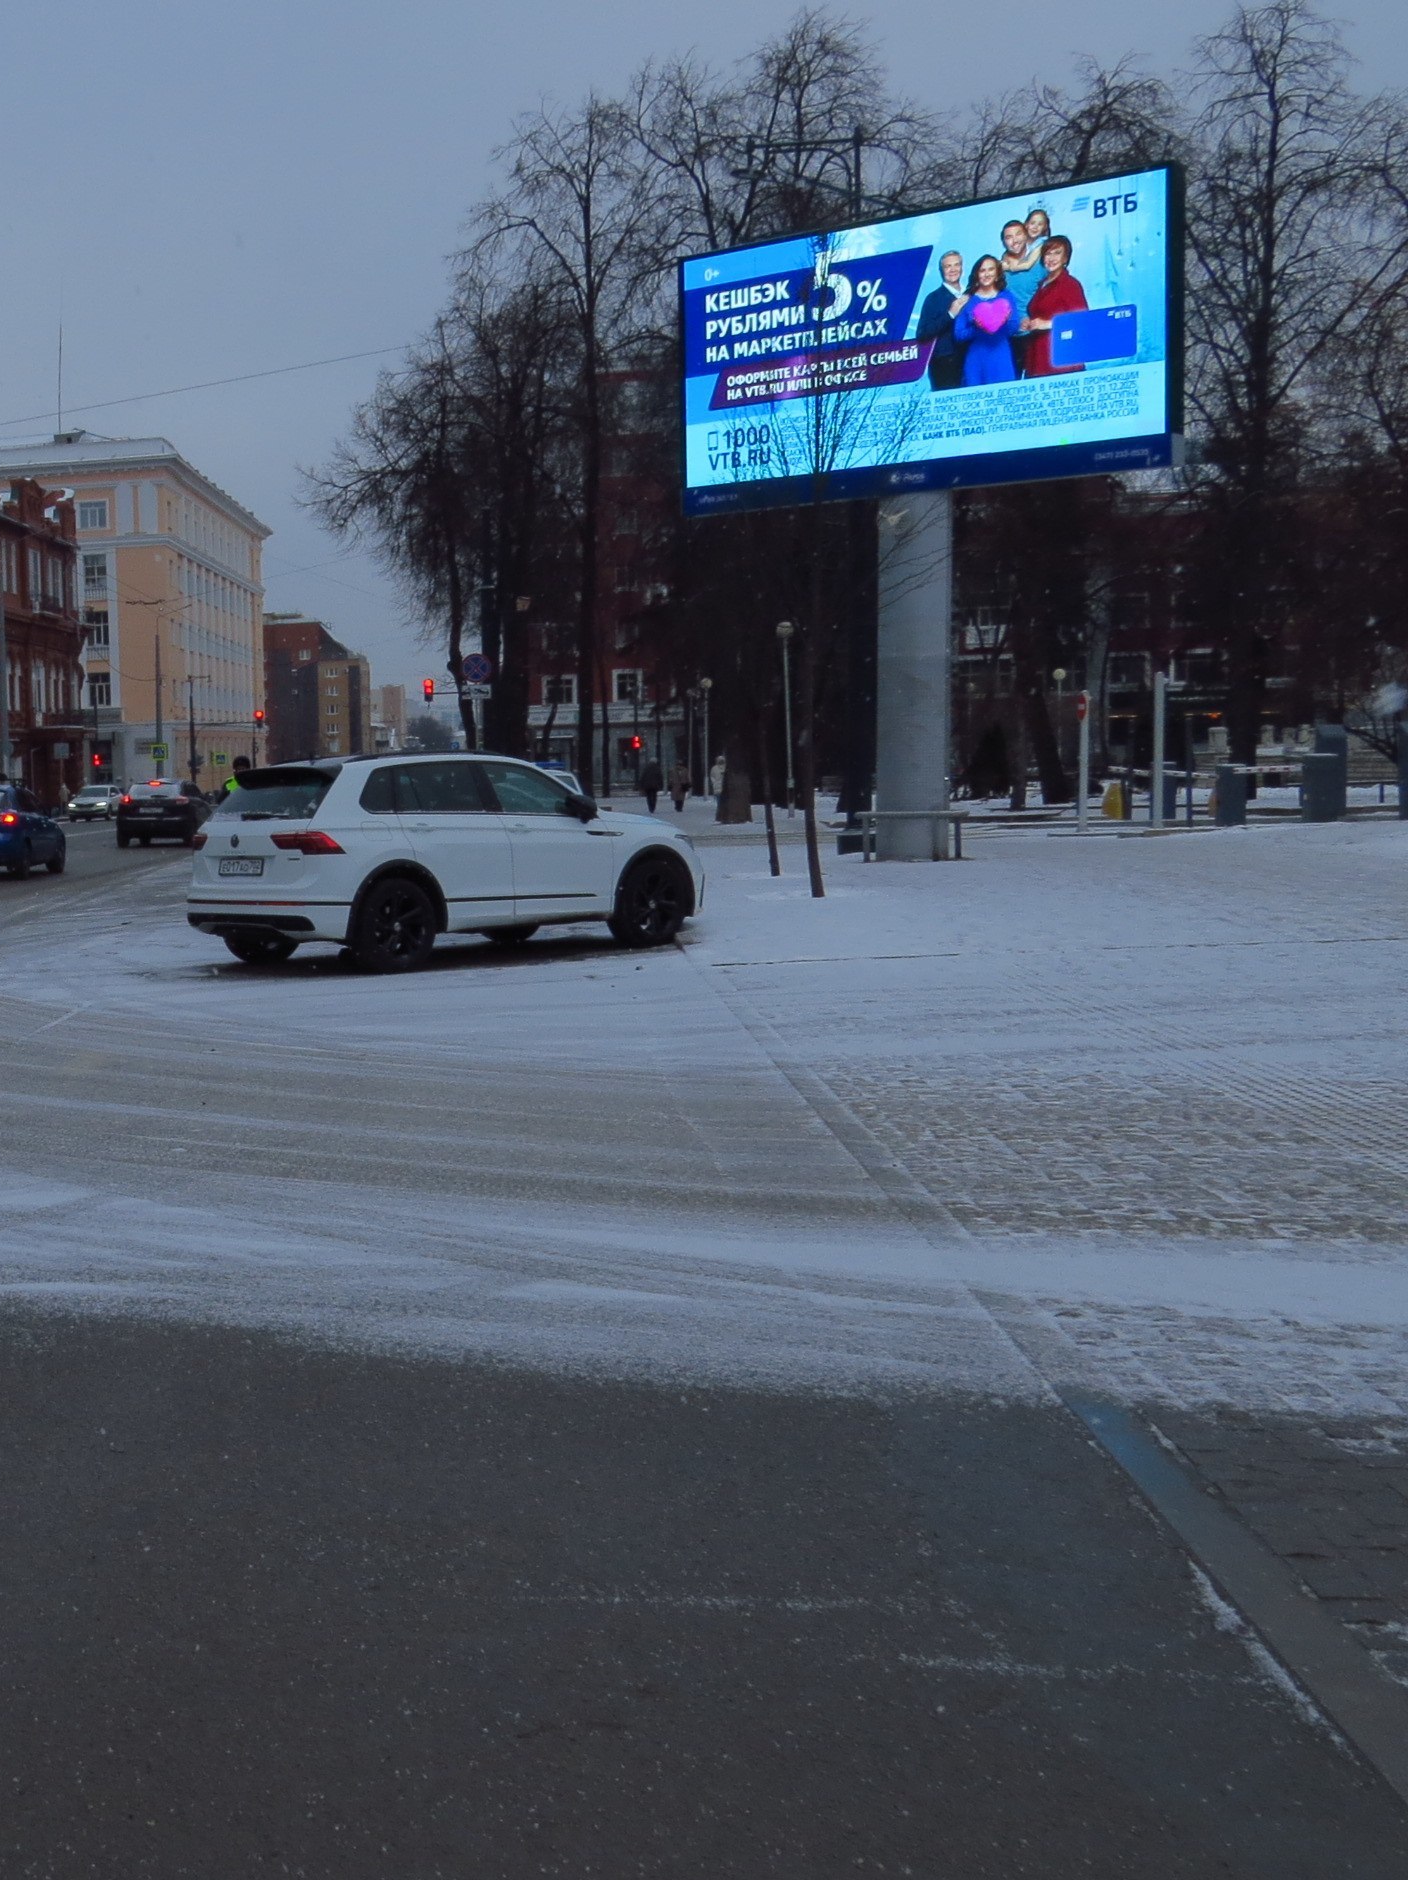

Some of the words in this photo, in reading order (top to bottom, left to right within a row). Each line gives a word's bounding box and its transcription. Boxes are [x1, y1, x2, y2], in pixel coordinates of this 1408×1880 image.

[1093, 192, 1138, 219] ВТБ
[704, 268, 720, 282] 0+
[705, 279, 790, 314] КЕШБЭК
[705, 304, 806, 340] РУБЛЯМИ
[1115, 310, 1132, 319] ВТБ
[706, 344, 730, 363] НА
[726, 366, 791, 387] ОФОРМИТЕ
[870, 344, 918, 366] СЕМЬЁЙ
[726, 388, 744, 401] НА
[723, 424, 771, 449] 1000
[708, 448, 771, 471] VTB.RU
